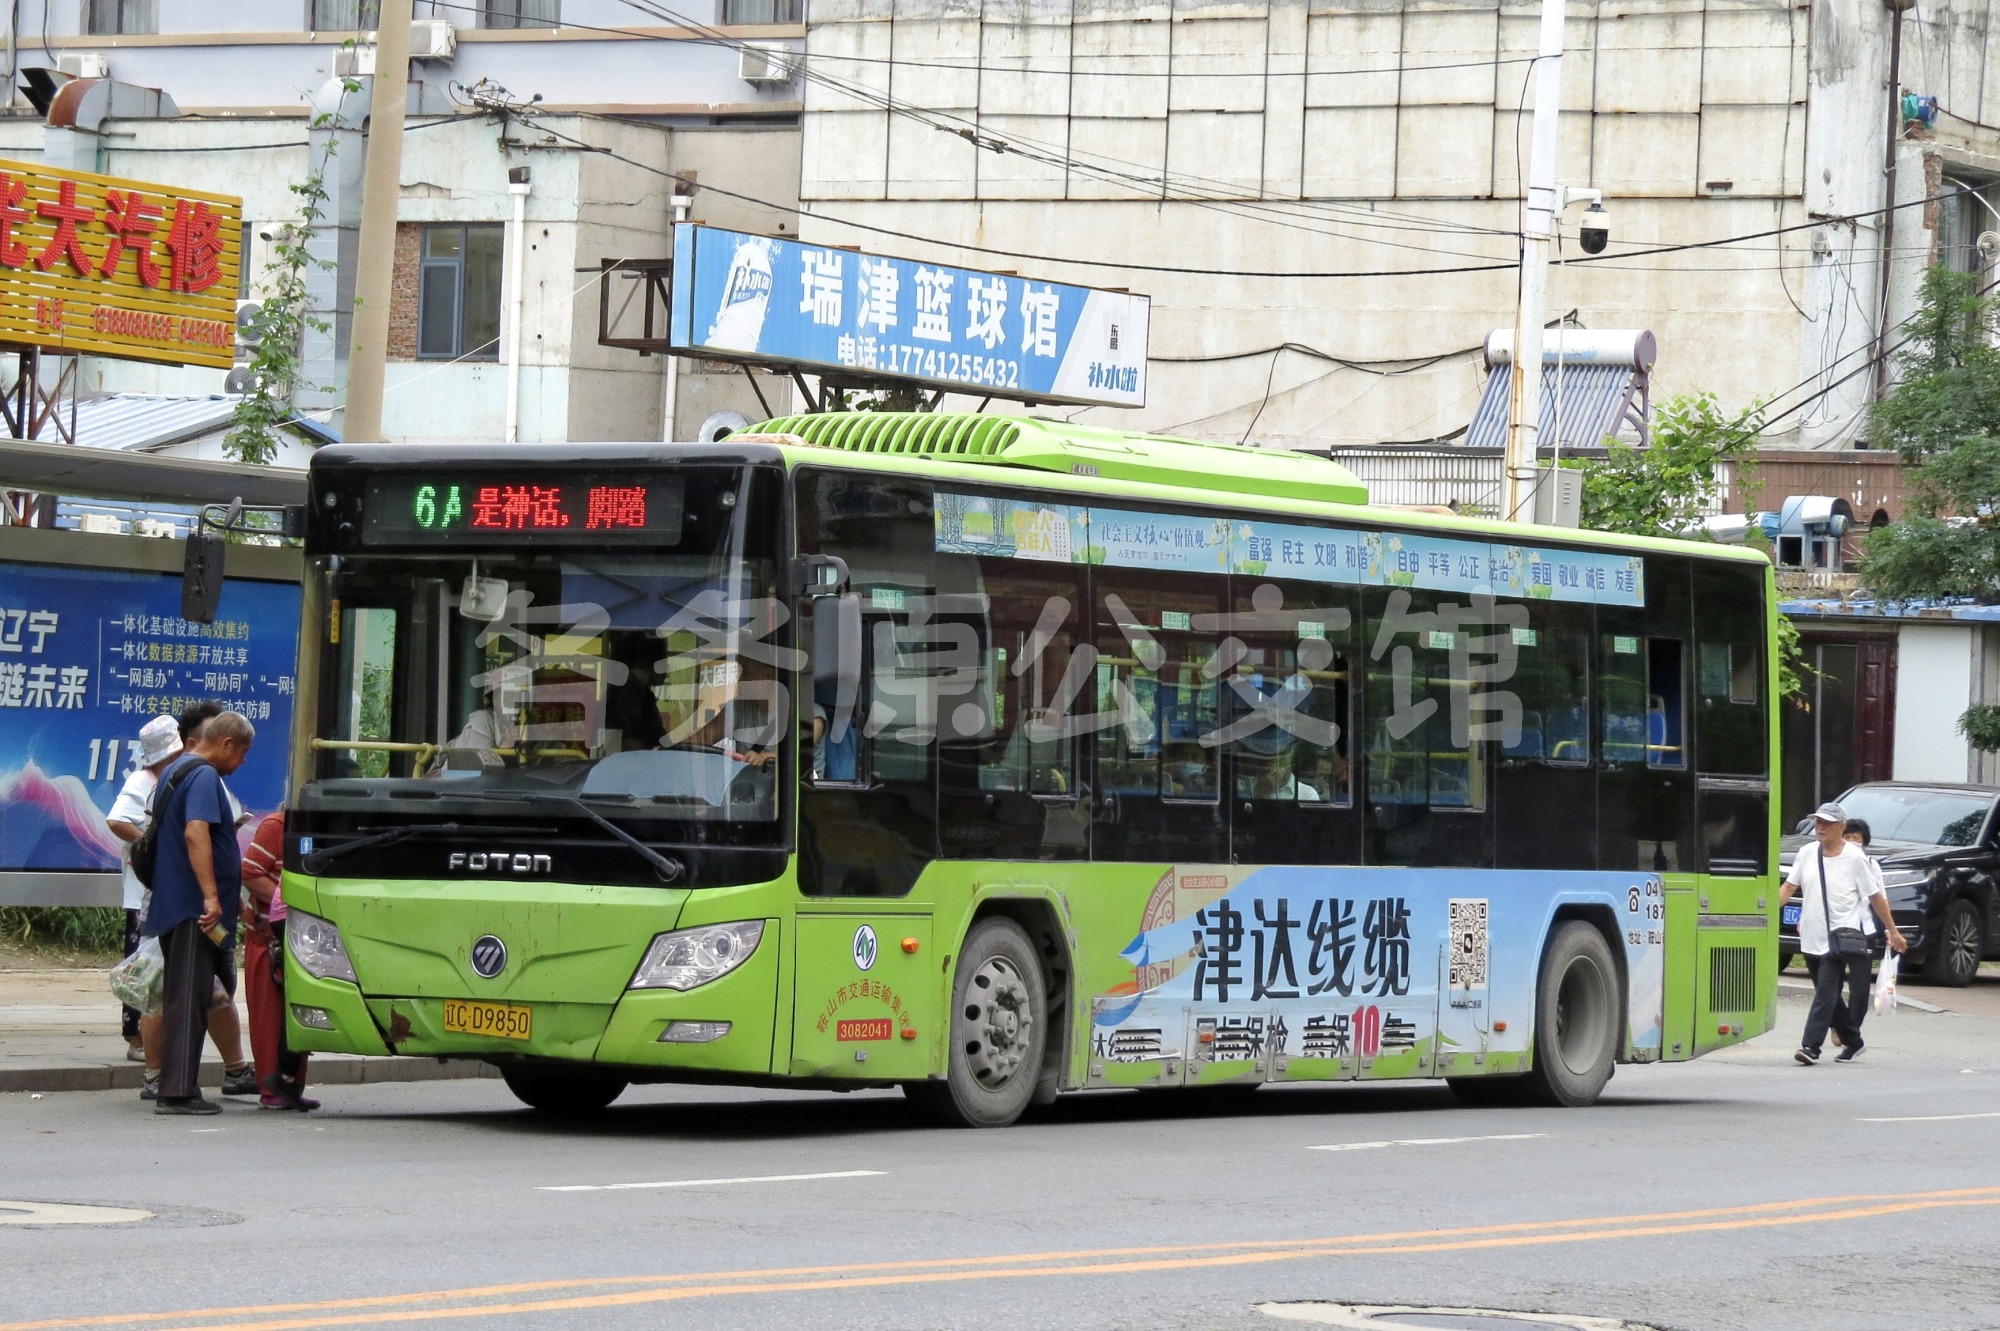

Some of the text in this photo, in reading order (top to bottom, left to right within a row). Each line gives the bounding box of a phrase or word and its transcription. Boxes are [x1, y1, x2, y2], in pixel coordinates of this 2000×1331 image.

[799, 249, 1060, 358] 瑞津篮球馆
[1088, 362, 1138, 393] 补水啦
[416, 486, 462, 528] 6A
[1101, 519, 1205, 549] 社会主义核心价值观
[1248, 536, 1368, 570] 富强 民主 文明 和谐
[1397, 548, 1509, 583] 自由 平等 公正 法治
[1531, 562, 1635, 593] 爱国 敬业 诚信 友善
[0, 607, 58, 653] 辽宁
[110, 613, 249, 640] 一体化基础设施高效集约
[110, 640, 248, 667] 一体化数据资源开放共享
[449, 852, 552, 872] FOTON
[1192, 897, 1411, 1002] 津达线缆
[840, 1023, 889, 1039] 3082041
